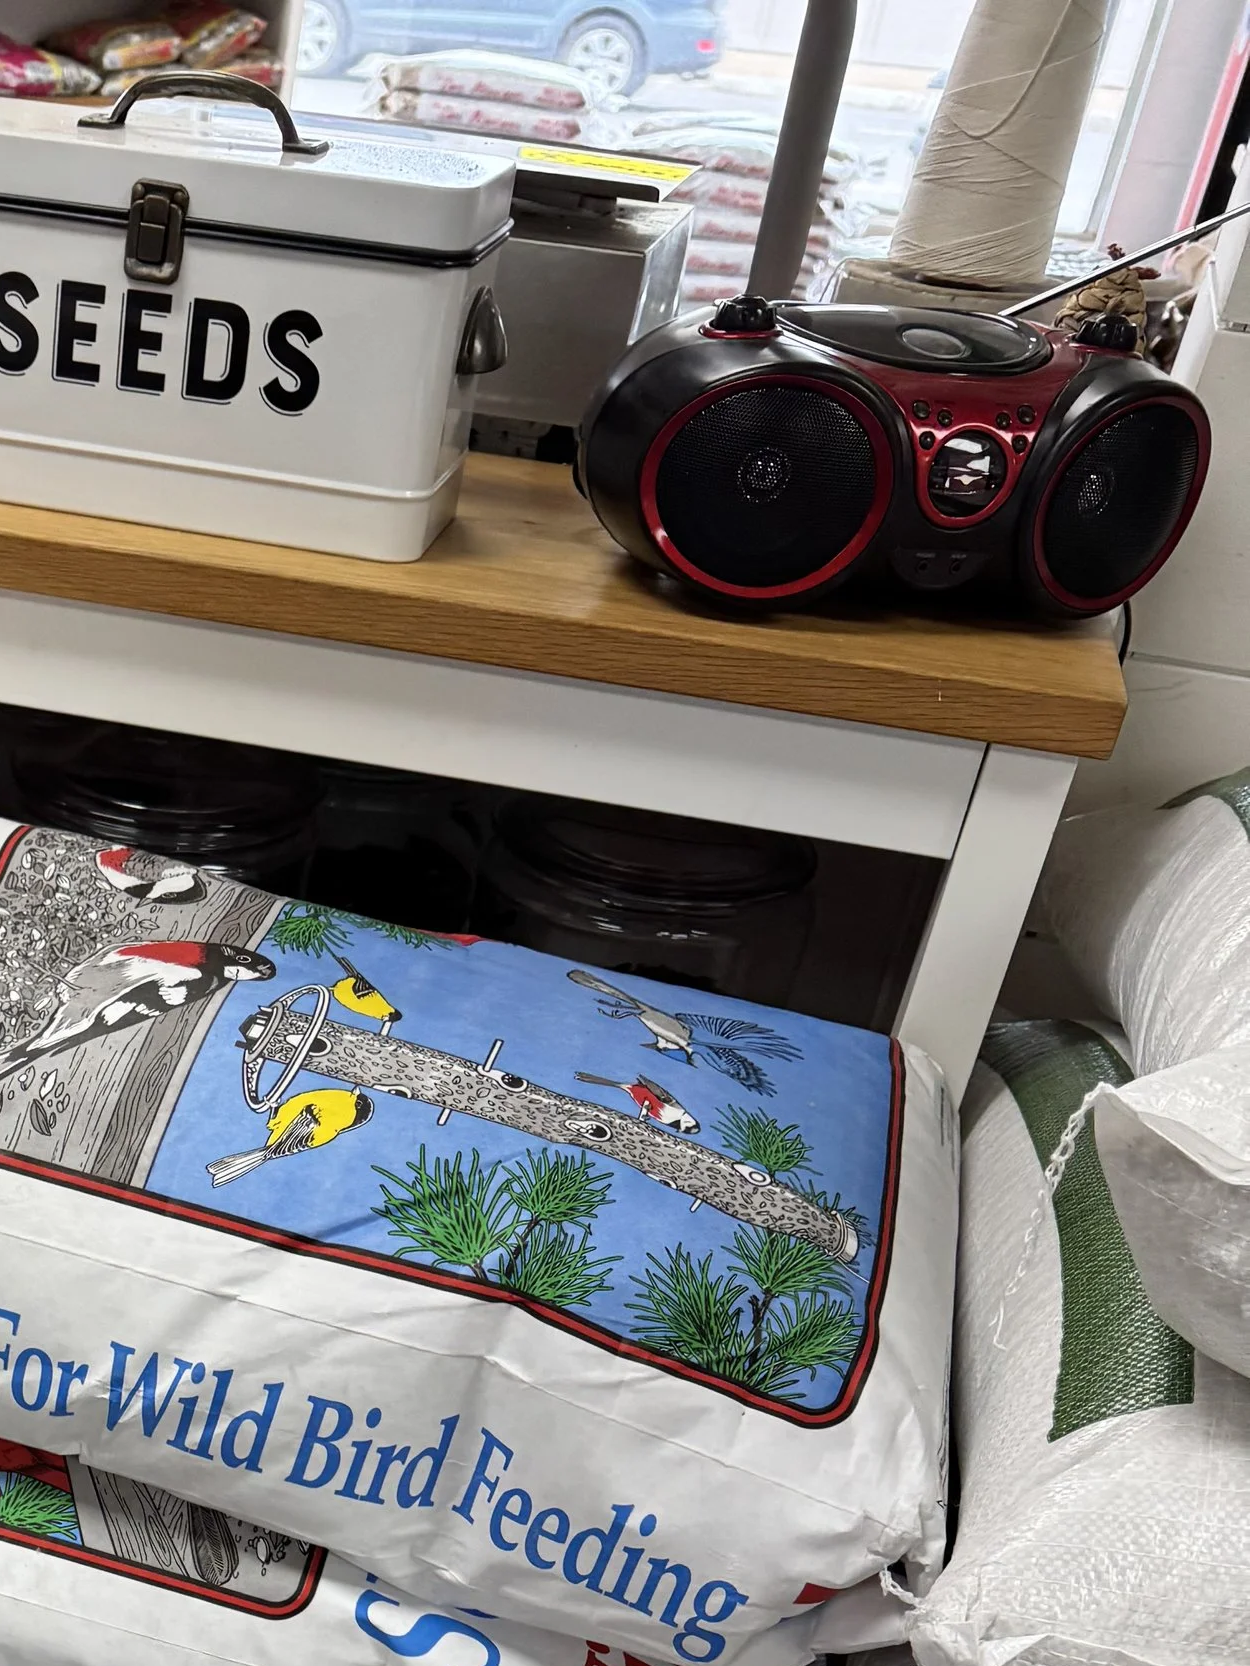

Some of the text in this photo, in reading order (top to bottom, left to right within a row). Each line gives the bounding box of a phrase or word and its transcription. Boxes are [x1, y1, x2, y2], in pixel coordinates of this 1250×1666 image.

[106, 1341, 282, 1473] Wild
[285, 1395, 459, 1509] Bird
[452, 1428, 749, 1664] Feeding
